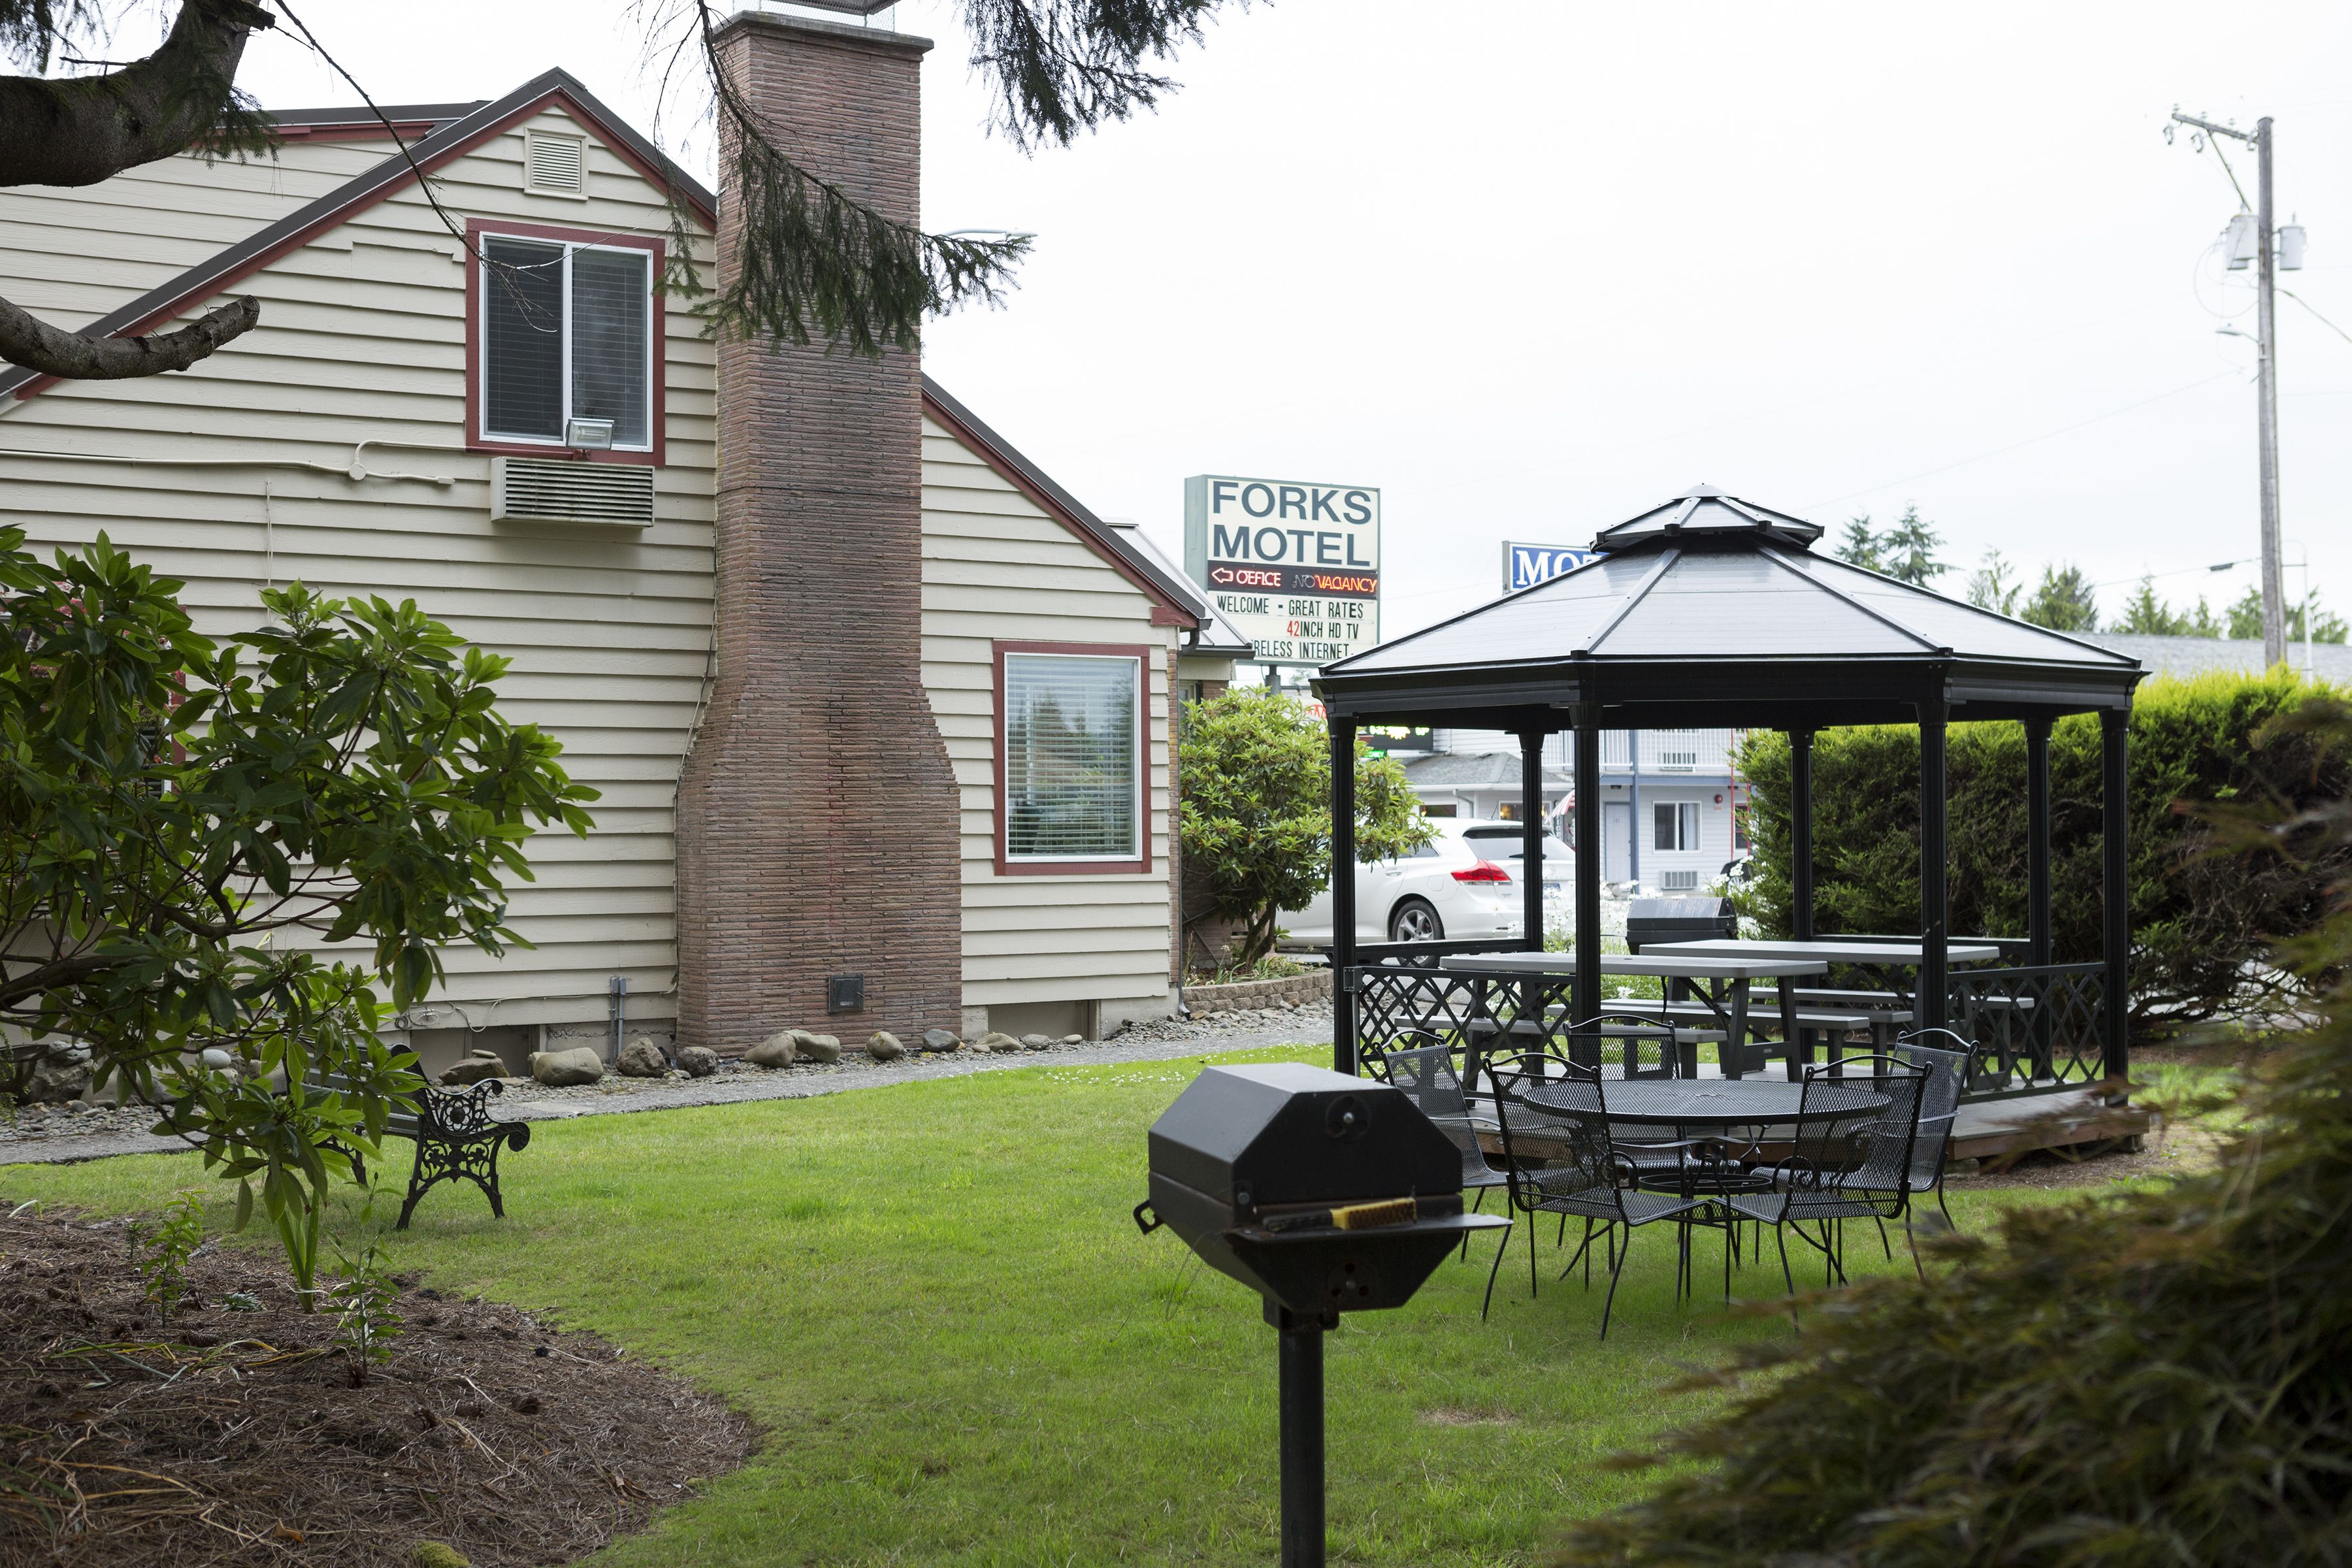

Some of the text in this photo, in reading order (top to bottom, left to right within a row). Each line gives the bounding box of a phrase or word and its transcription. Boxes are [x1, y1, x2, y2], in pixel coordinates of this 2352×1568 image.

[1213, 480, 1371, 525] FORKS
[1213, 524, 1370, 566] MOTEL
[1236, 570, 1282, 587] OFFICE
[1314, 574, 1377, 593] VACANCY
[1217, 595, 1269, 614] WELCOME
[1288, 599, 1321, 617] GREAT
[1328, 601, 1364, 619] RATES
[1329, 623, 1341, 639] HD
[1347, 623, 1359, 640] TV
[1251, 640, 1349, 659] RELESS INTERNET
